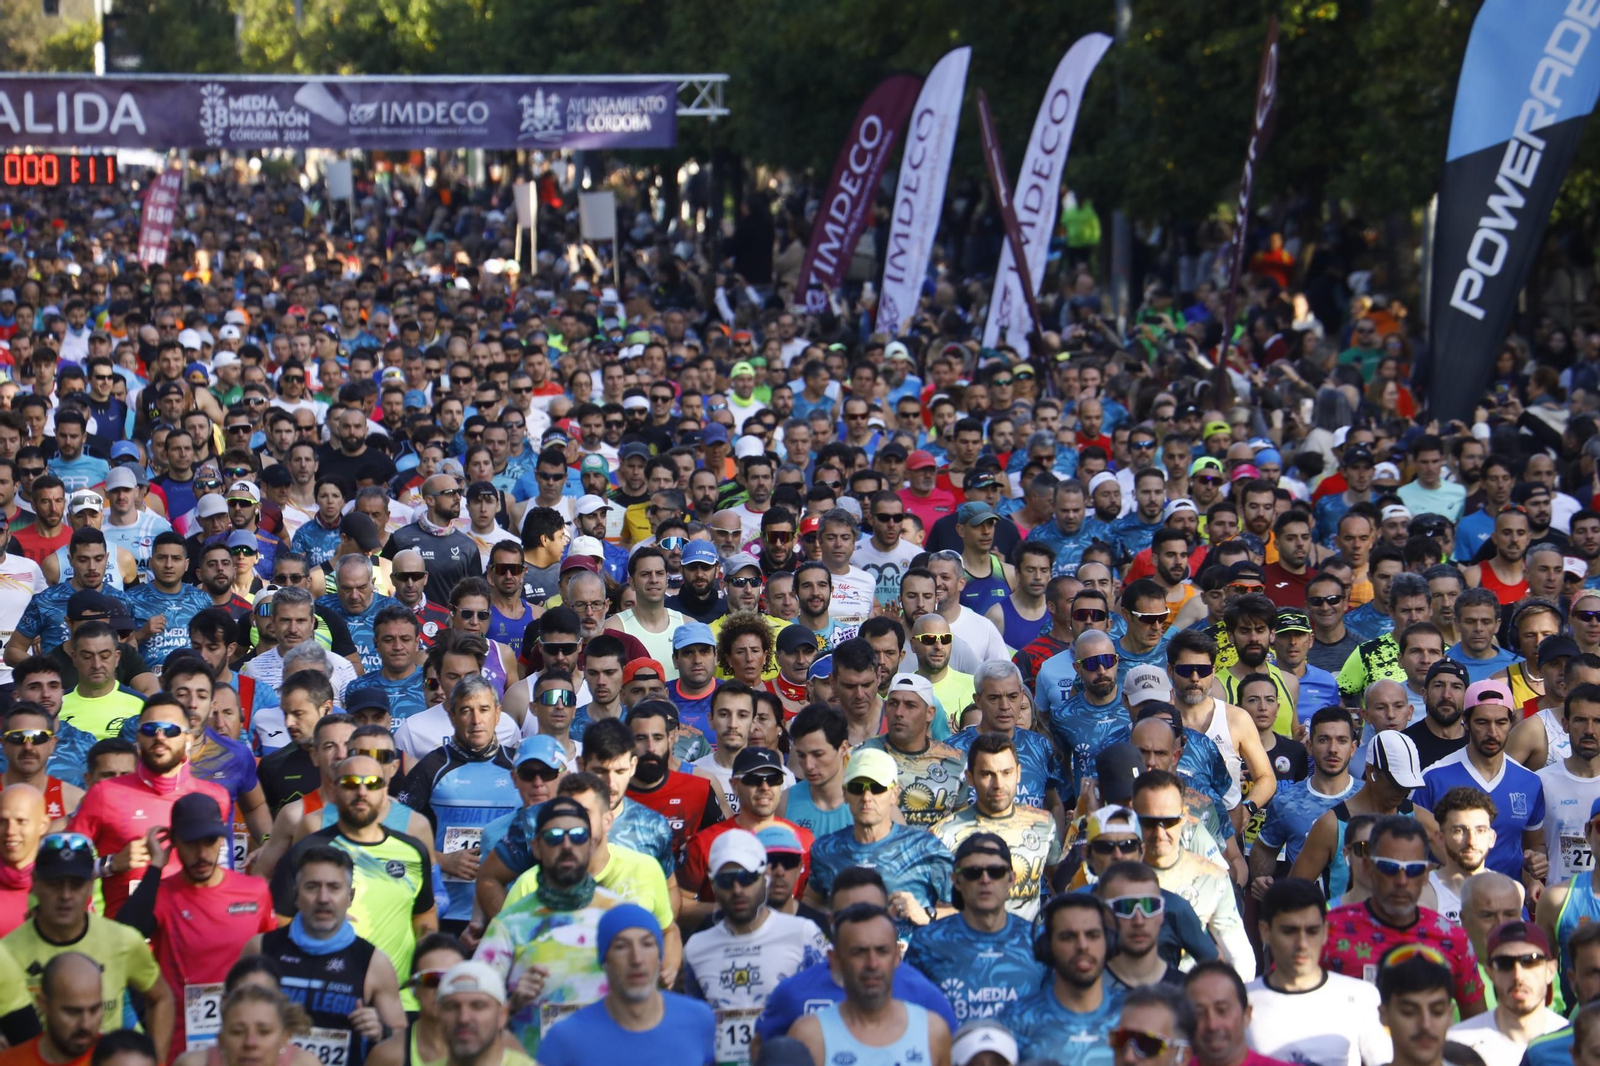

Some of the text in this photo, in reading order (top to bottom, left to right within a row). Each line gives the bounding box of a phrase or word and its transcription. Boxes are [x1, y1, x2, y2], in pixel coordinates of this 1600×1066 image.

[229, 95, 279, 111] MEDIA
[566, 95, 668, 114] AYUNTAMIENTO
[200, 105, 310, 128] 38 MARATÓN
[381, 101, 489, 124] IMDECO
[283, 129, 309, 141] 2024
[1450, 0, 1600, 320] POWERADE
[812, 114, 883, 276] IMDECO
[885, 107, 935, 284] IMDECO
[164, 628, 189, 637] MEDI
[1135, 675, 1161, 685] QUIKSILVER
[442, 807, 482, 824] MEDIA
[234, 845, 245, 861] 2
[967, 987, 1018, 1002] MEDIA
[204, 1000, 217, 1019] 2
